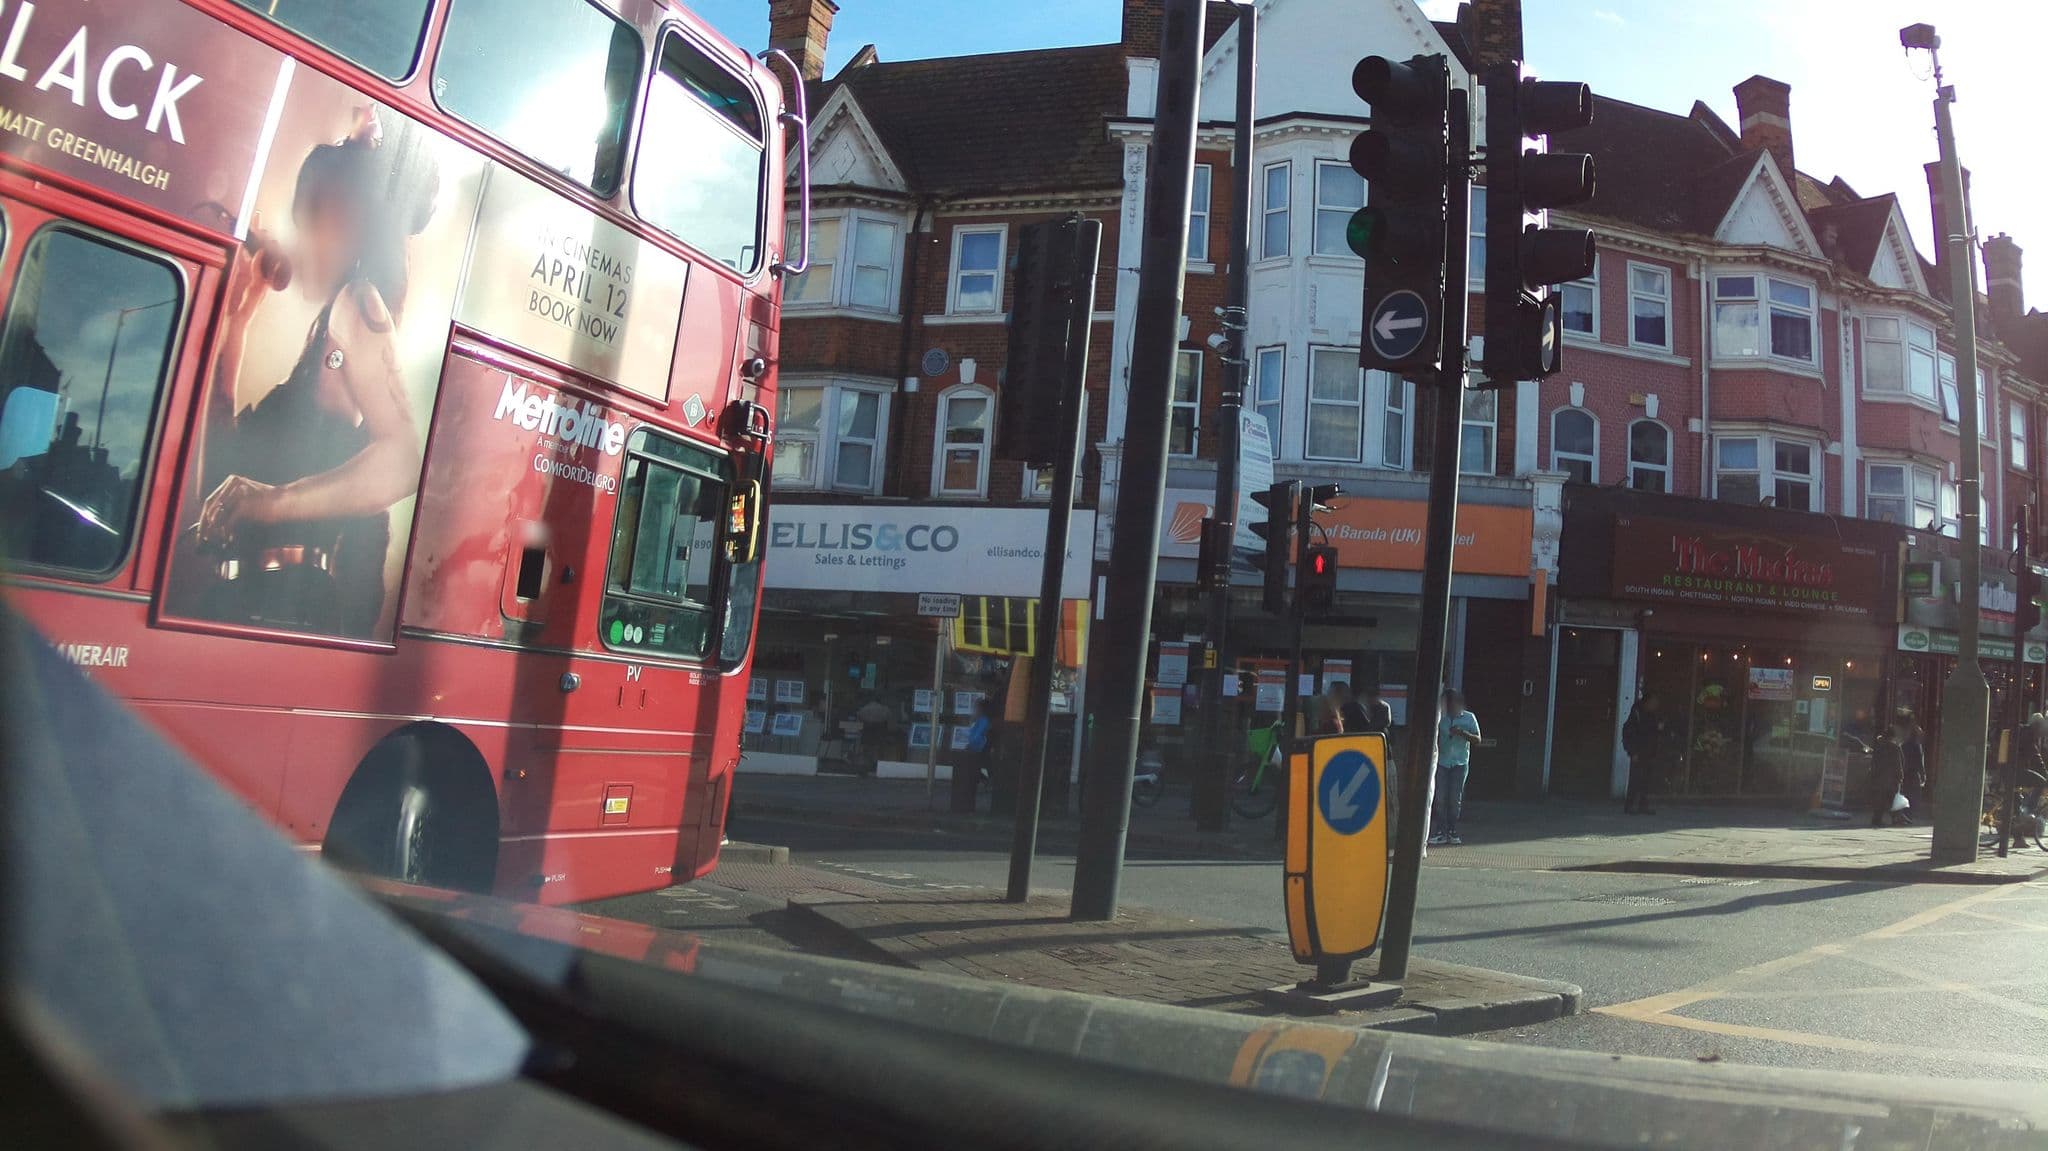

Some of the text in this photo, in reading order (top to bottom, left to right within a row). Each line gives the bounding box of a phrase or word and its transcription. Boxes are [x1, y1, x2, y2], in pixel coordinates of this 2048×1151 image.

[0, 0, 204, 145] LACK
[47, 128, 171, 190] GREENHALGH
[563, 236, 632, 284] CINEMAS
[531, 253, 627, 319] APRIL 12
[529, 290, 618, 344] BOOK NOW
[494, 373, 625, 456] Metroline
[1340, 524, 1387, 541] Baroda
[1389, 527, 1422, 545] (UK)
[815, 554, 906, 570] Sales & Lettings
[1672, 535, 1728, 574] The
[932, 595, 957, 606] loading
[1625, 585, 1649, 595] SOUTH
[1663, 575, 1840, 601] RESTAURANT & LOUNGE
[626, 665, 642, 682] PV
